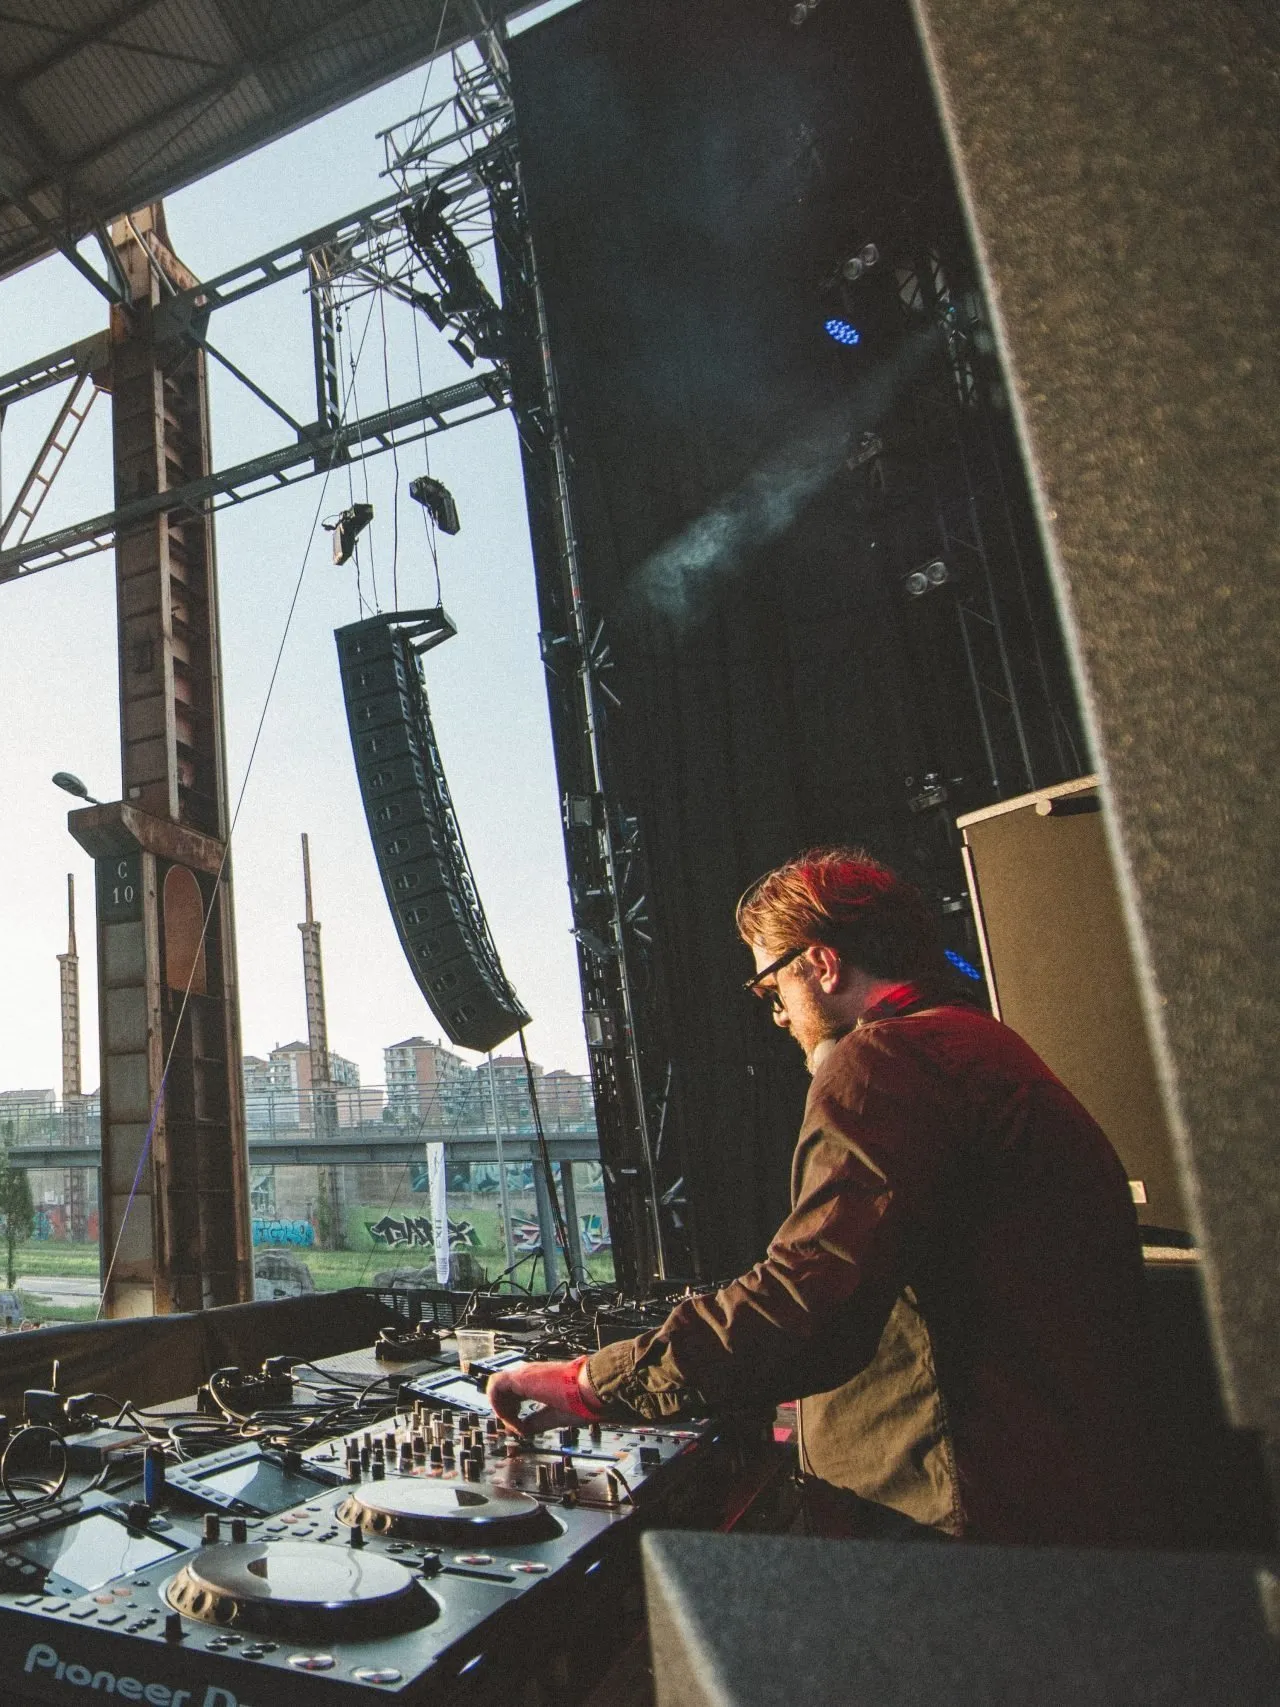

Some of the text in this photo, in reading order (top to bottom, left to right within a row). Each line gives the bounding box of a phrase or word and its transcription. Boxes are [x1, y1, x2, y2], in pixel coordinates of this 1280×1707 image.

[118, 861, 128, 879] C
[113, 885, 134, 903] 10
[24, 1643, 192, 1707] Pioneer
